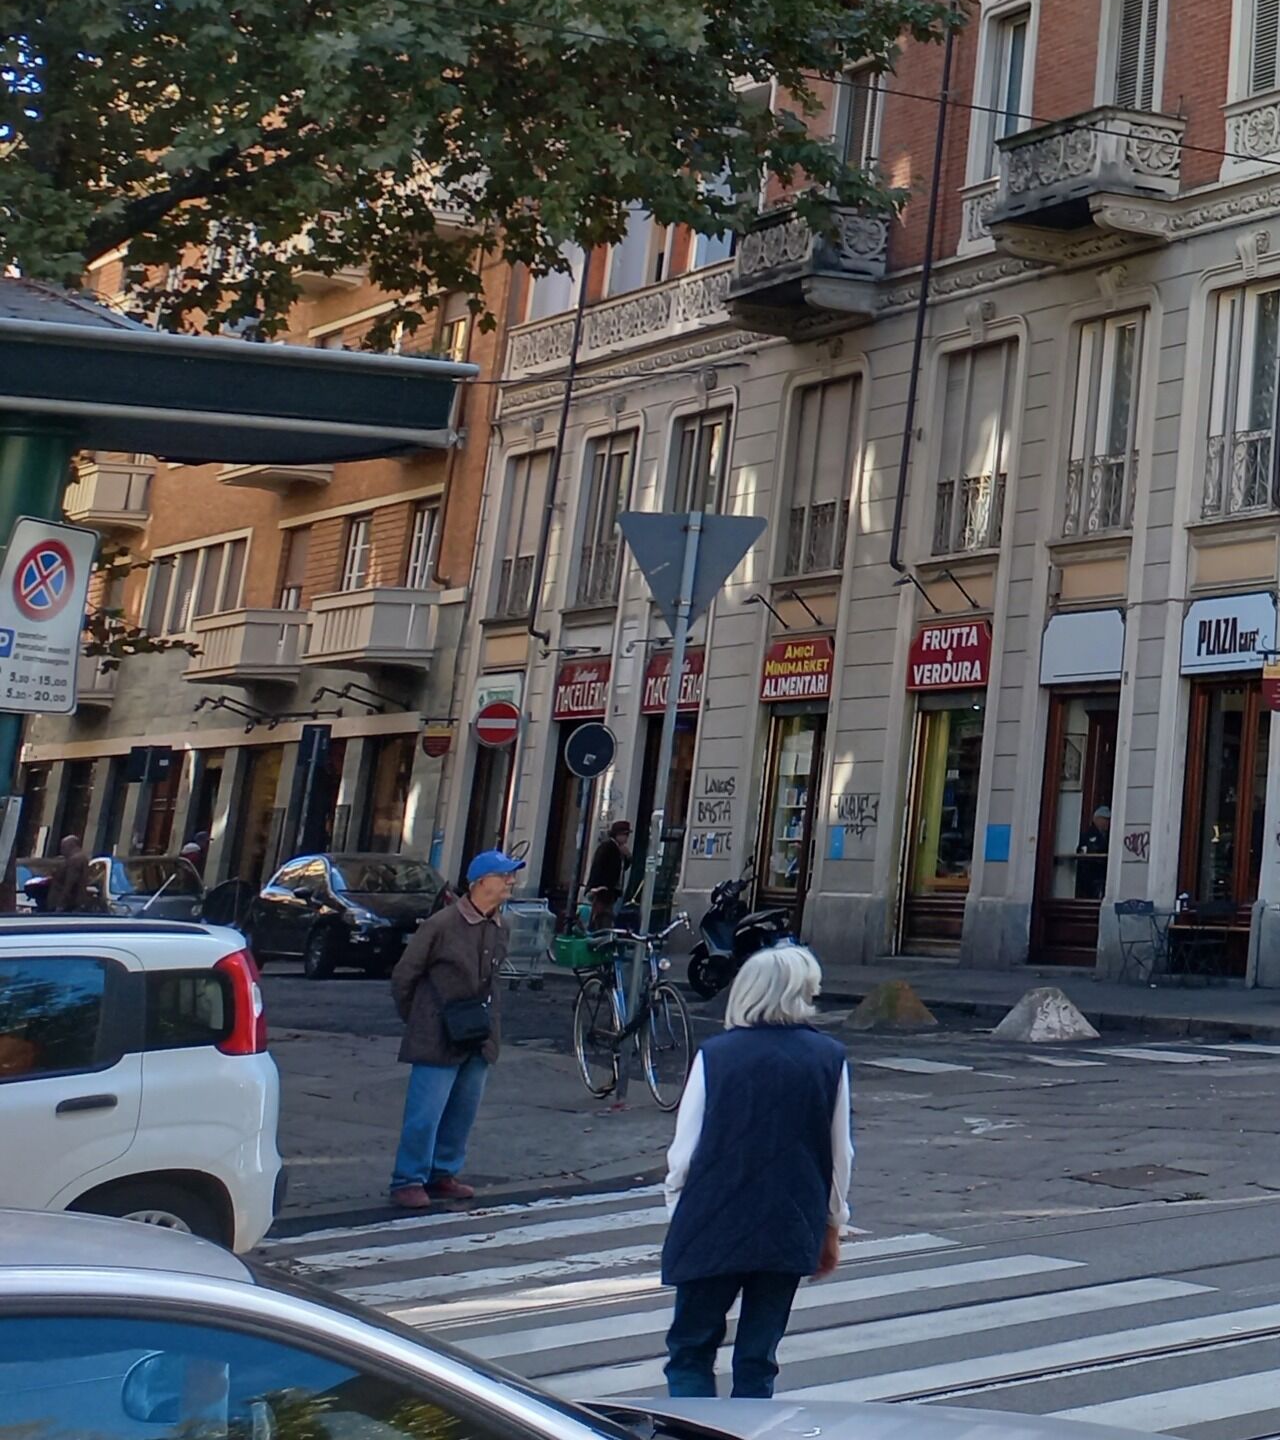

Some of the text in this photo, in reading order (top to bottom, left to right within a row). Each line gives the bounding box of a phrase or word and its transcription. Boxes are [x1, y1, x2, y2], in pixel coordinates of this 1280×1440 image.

[922, 626, 978, 651] FRUTTA
[1197, 617, 1237, 656] PLAZA
[913, 660, 982, 685] VERDURA
[762, 674, 828, 698] ALIMENTARI
